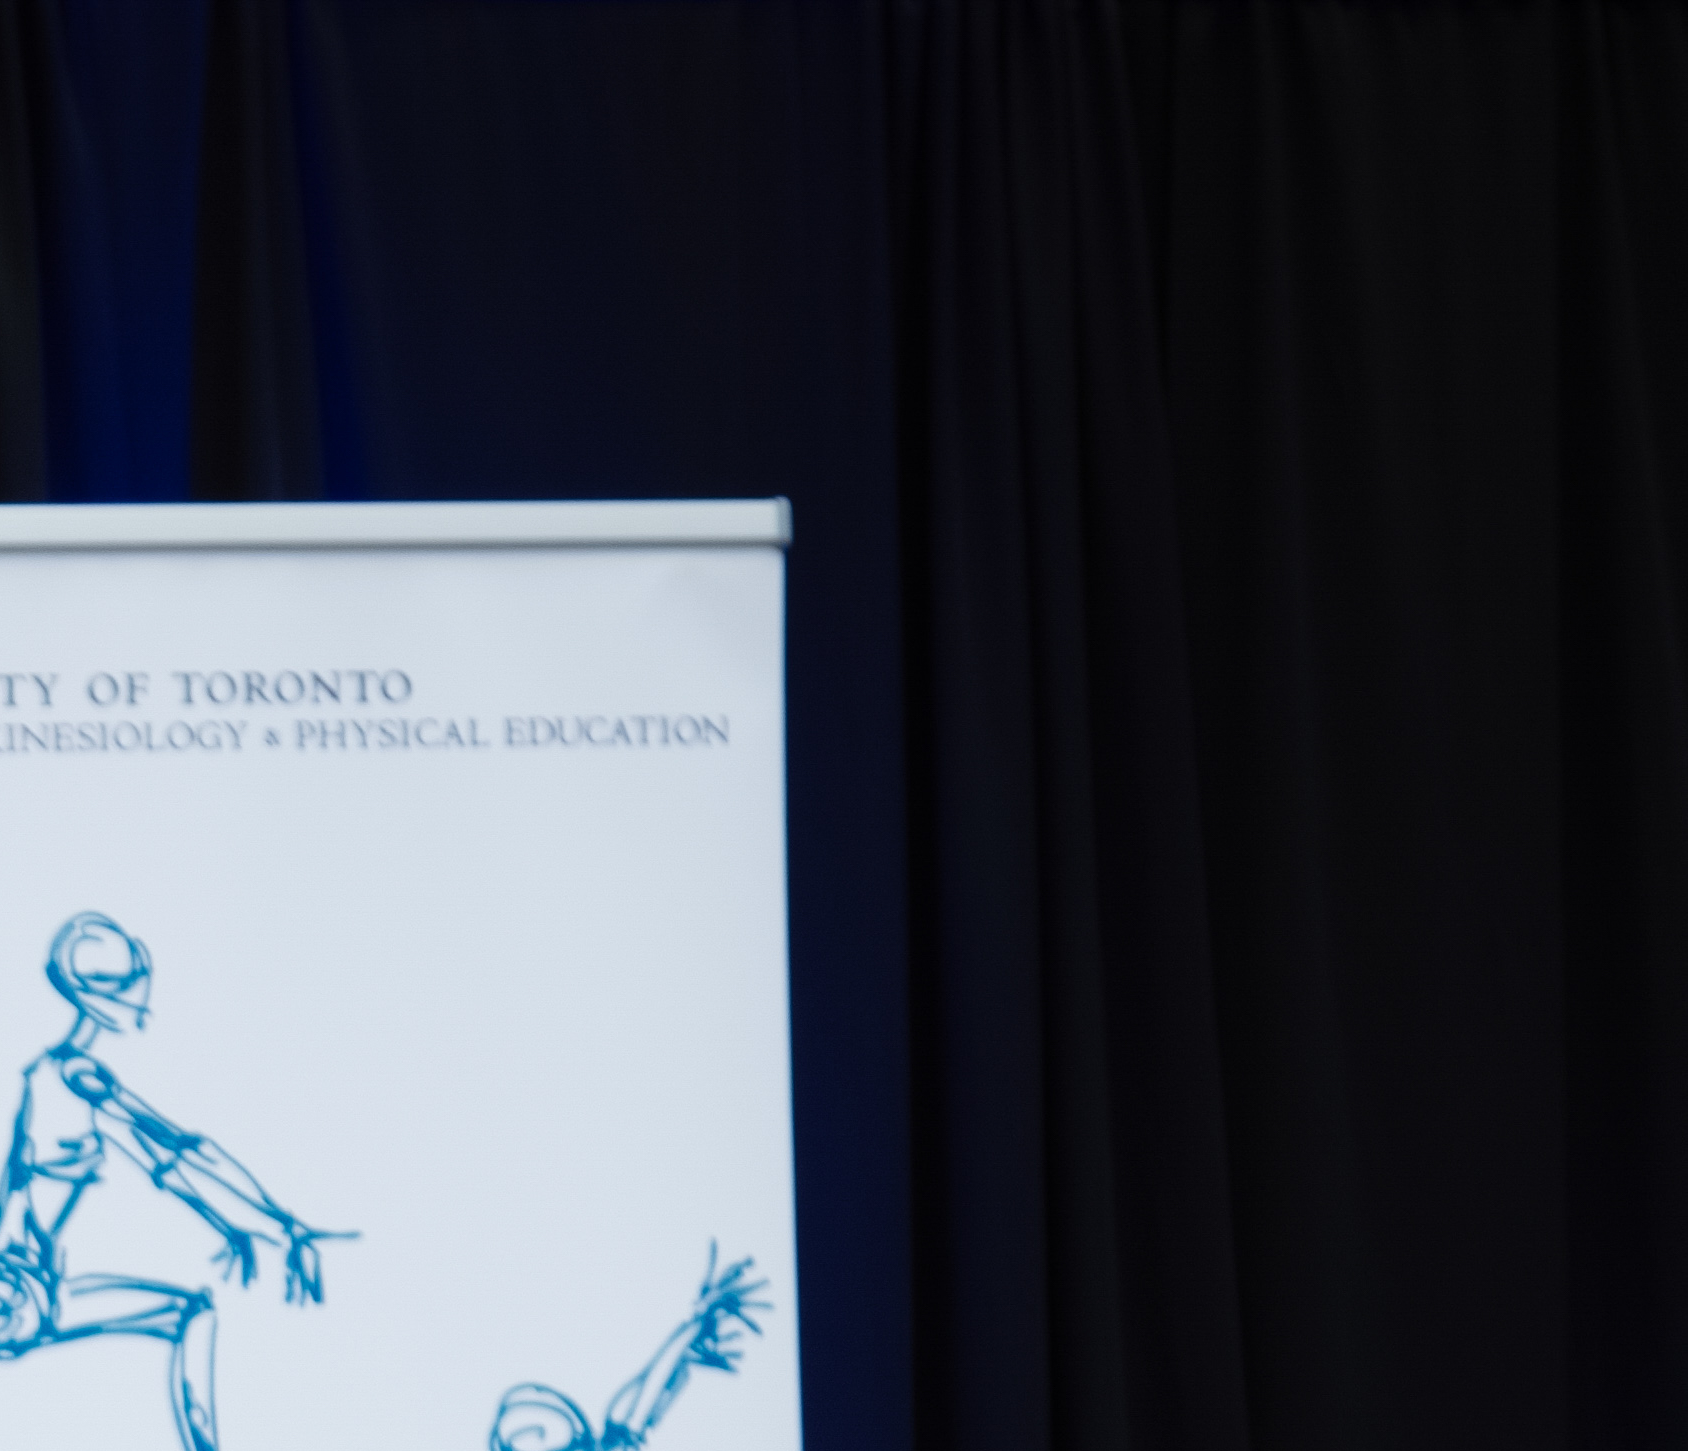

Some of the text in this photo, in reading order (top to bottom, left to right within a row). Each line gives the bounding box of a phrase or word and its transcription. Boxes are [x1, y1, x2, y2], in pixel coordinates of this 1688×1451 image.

[85, 673, 149, 708] OF
[174, 669, 415, 707] TORONTO
[294, 717, 490, 751] PHYSICAL
[504, 714, 731, 748] EDUCATION
